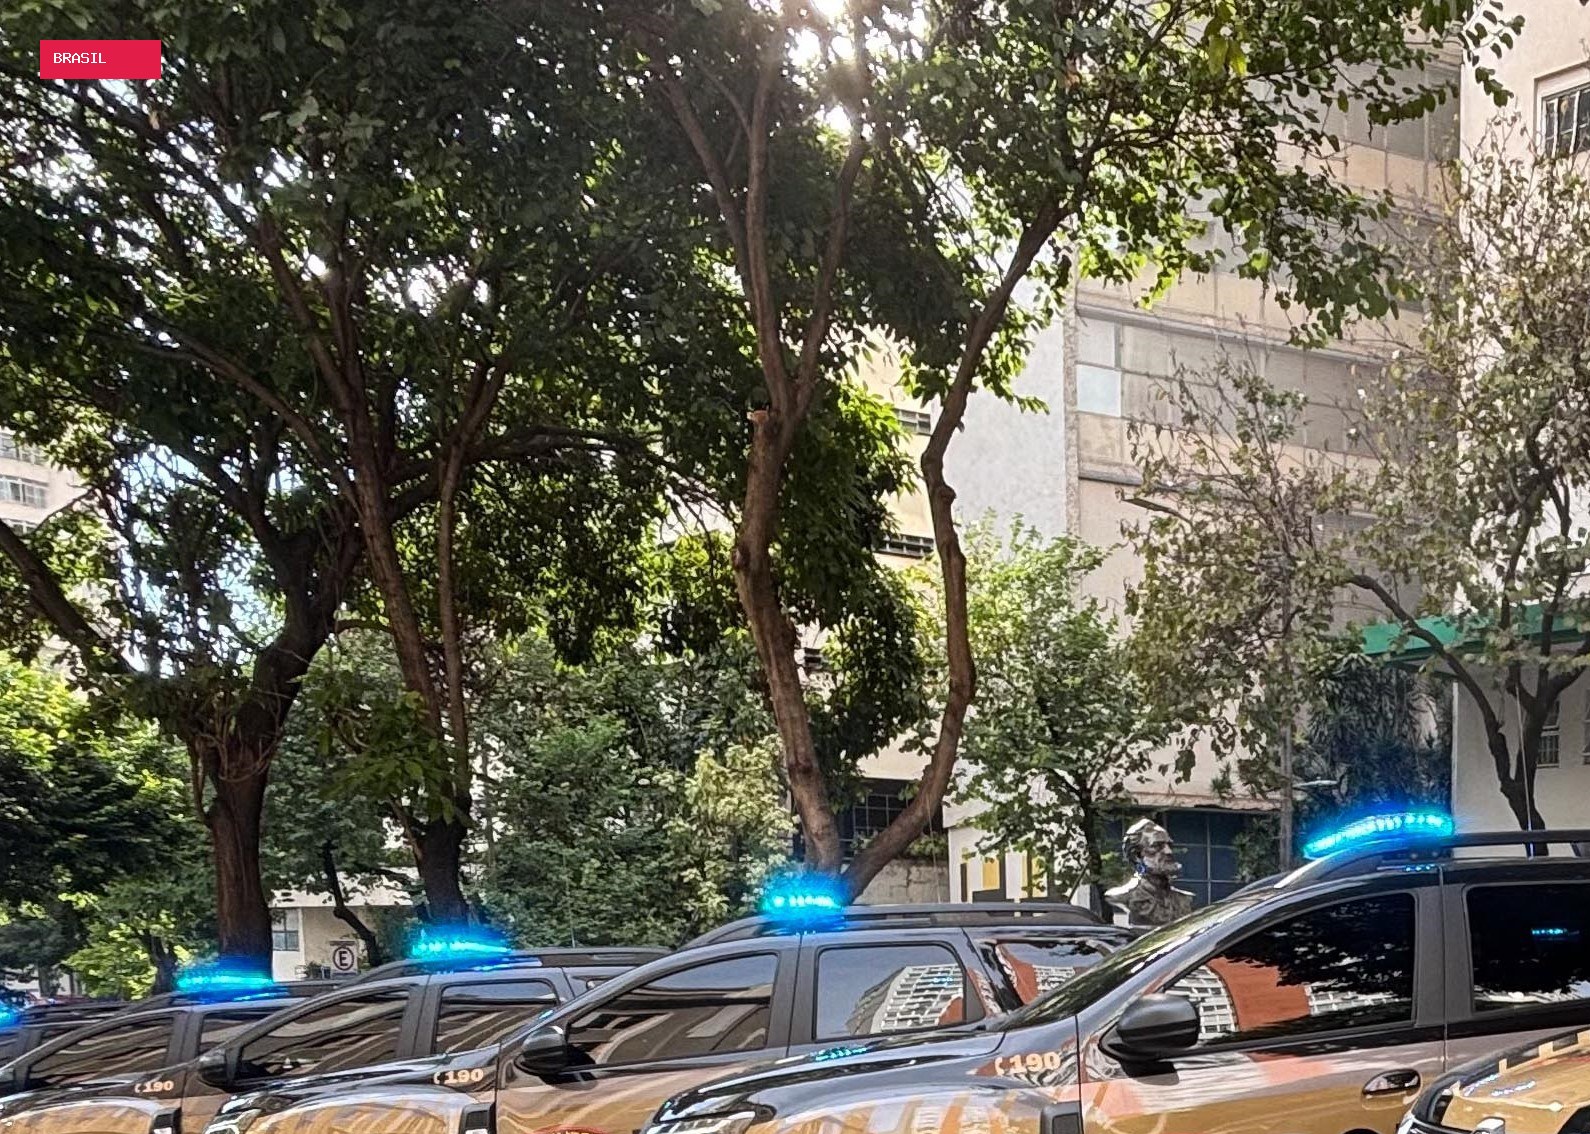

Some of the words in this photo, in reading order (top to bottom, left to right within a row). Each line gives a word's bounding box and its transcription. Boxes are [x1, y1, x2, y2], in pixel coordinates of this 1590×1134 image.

[339, 950, 349, 967] E
[1009, 1051, 1061, 1074] 190
[444, 1068, 484, 1085] 190
